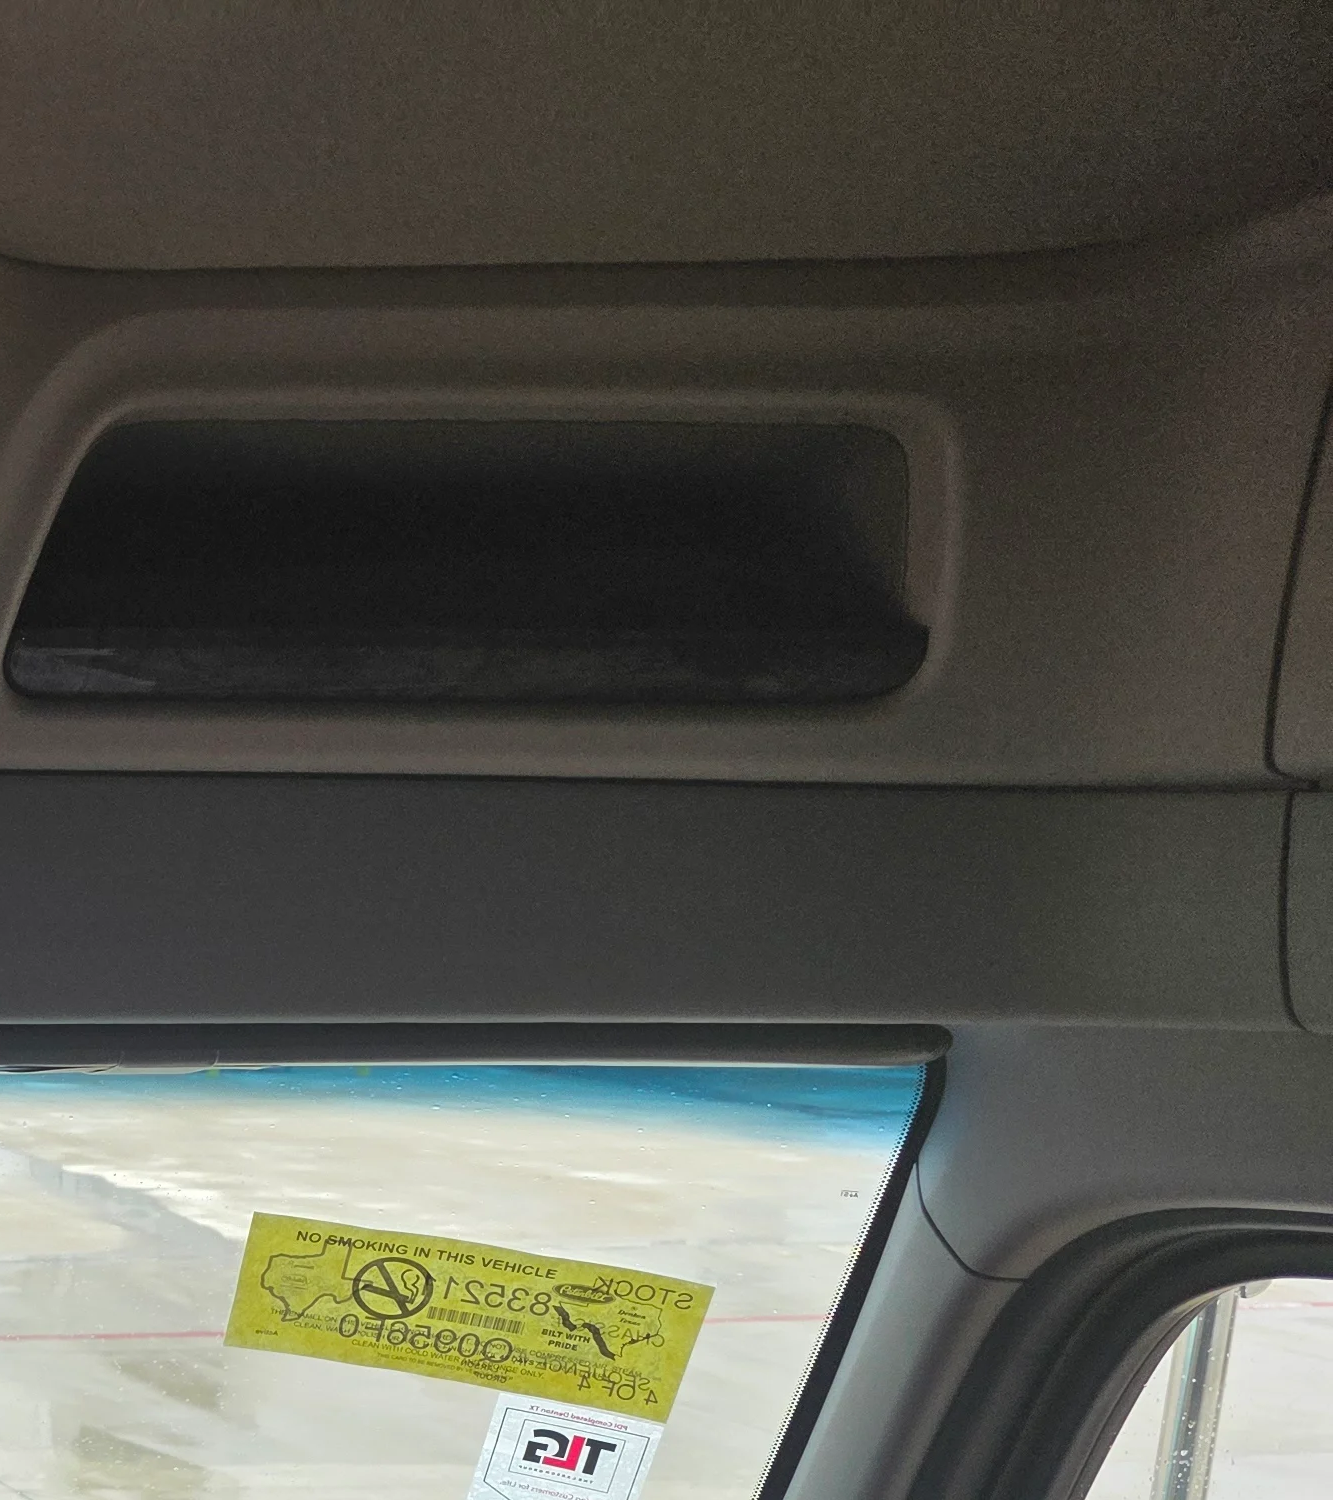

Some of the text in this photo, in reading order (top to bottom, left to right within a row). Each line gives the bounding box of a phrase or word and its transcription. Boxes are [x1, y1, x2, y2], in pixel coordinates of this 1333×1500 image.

[296, 1230, 558, 1279] NO SMOKING IN THIS VEHICLE
[541, 1328, 591, 1344] BILT WITH
[548, 1339, 578, 1351] PRIDE
[352, 1338, 380, 1350] CLEAN
[382, 1343, 404, 1353] WITH
[404, 1346, 428, 1356] COLD
[430, 1351, 461, 1363] WATER
[520, 1368, 544, 1379] ONLY.
